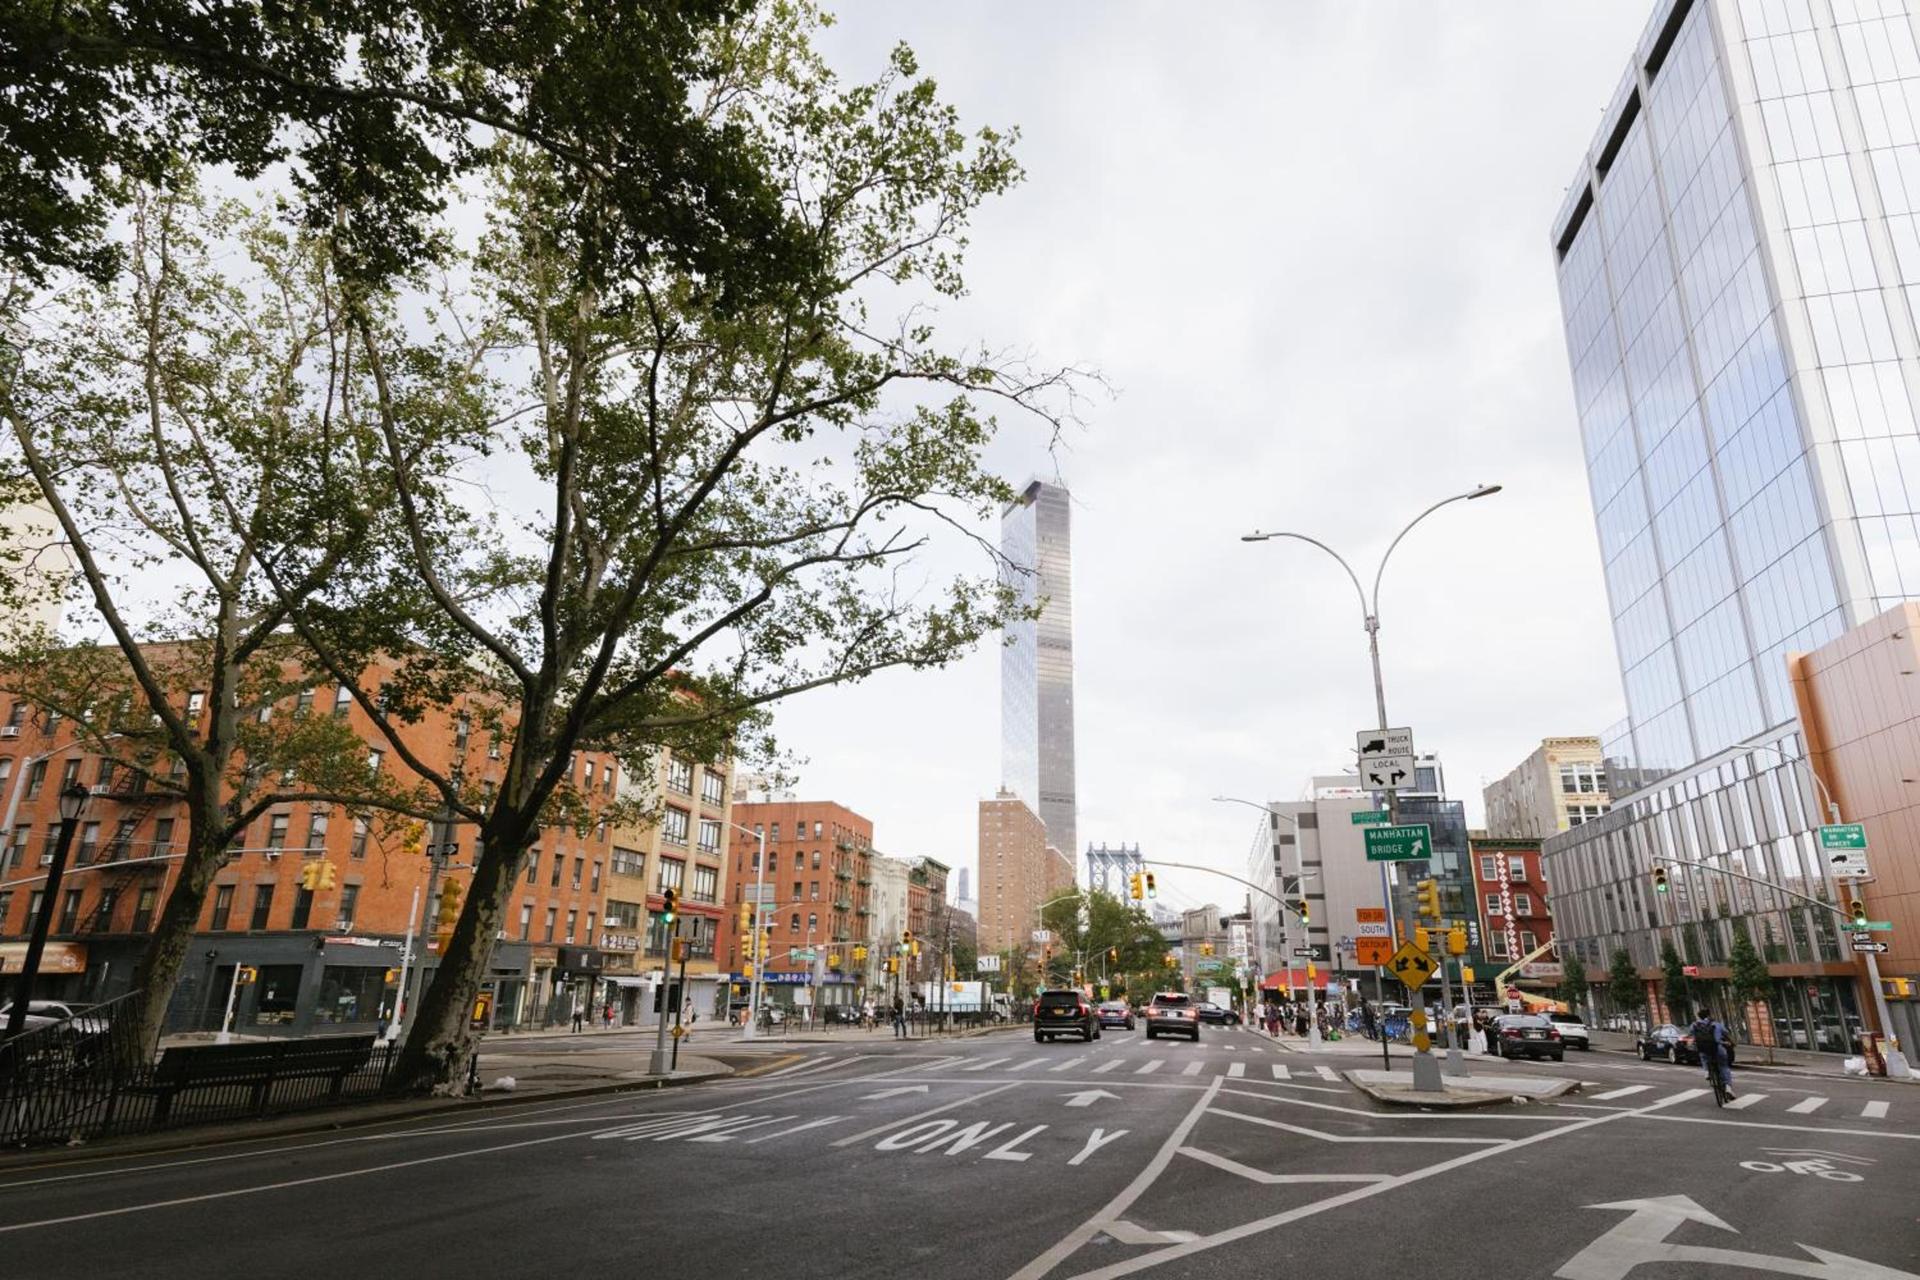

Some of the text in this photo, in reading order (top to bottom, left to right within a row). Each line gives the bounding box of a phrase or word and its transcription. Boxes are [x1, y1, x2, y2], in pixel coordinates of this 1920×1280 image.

[1373, 760, 1400, 768] LOCAL
[1369, 828, 1424, 840] MANHATTAN
[1371, 844, 1405, 855] BRIDGE
[1360, 924, 1386, 934] SOUTH
[1360, 940, 1389, 948] DETOUR
[875, 1119, 1131, 1166] ONLY
